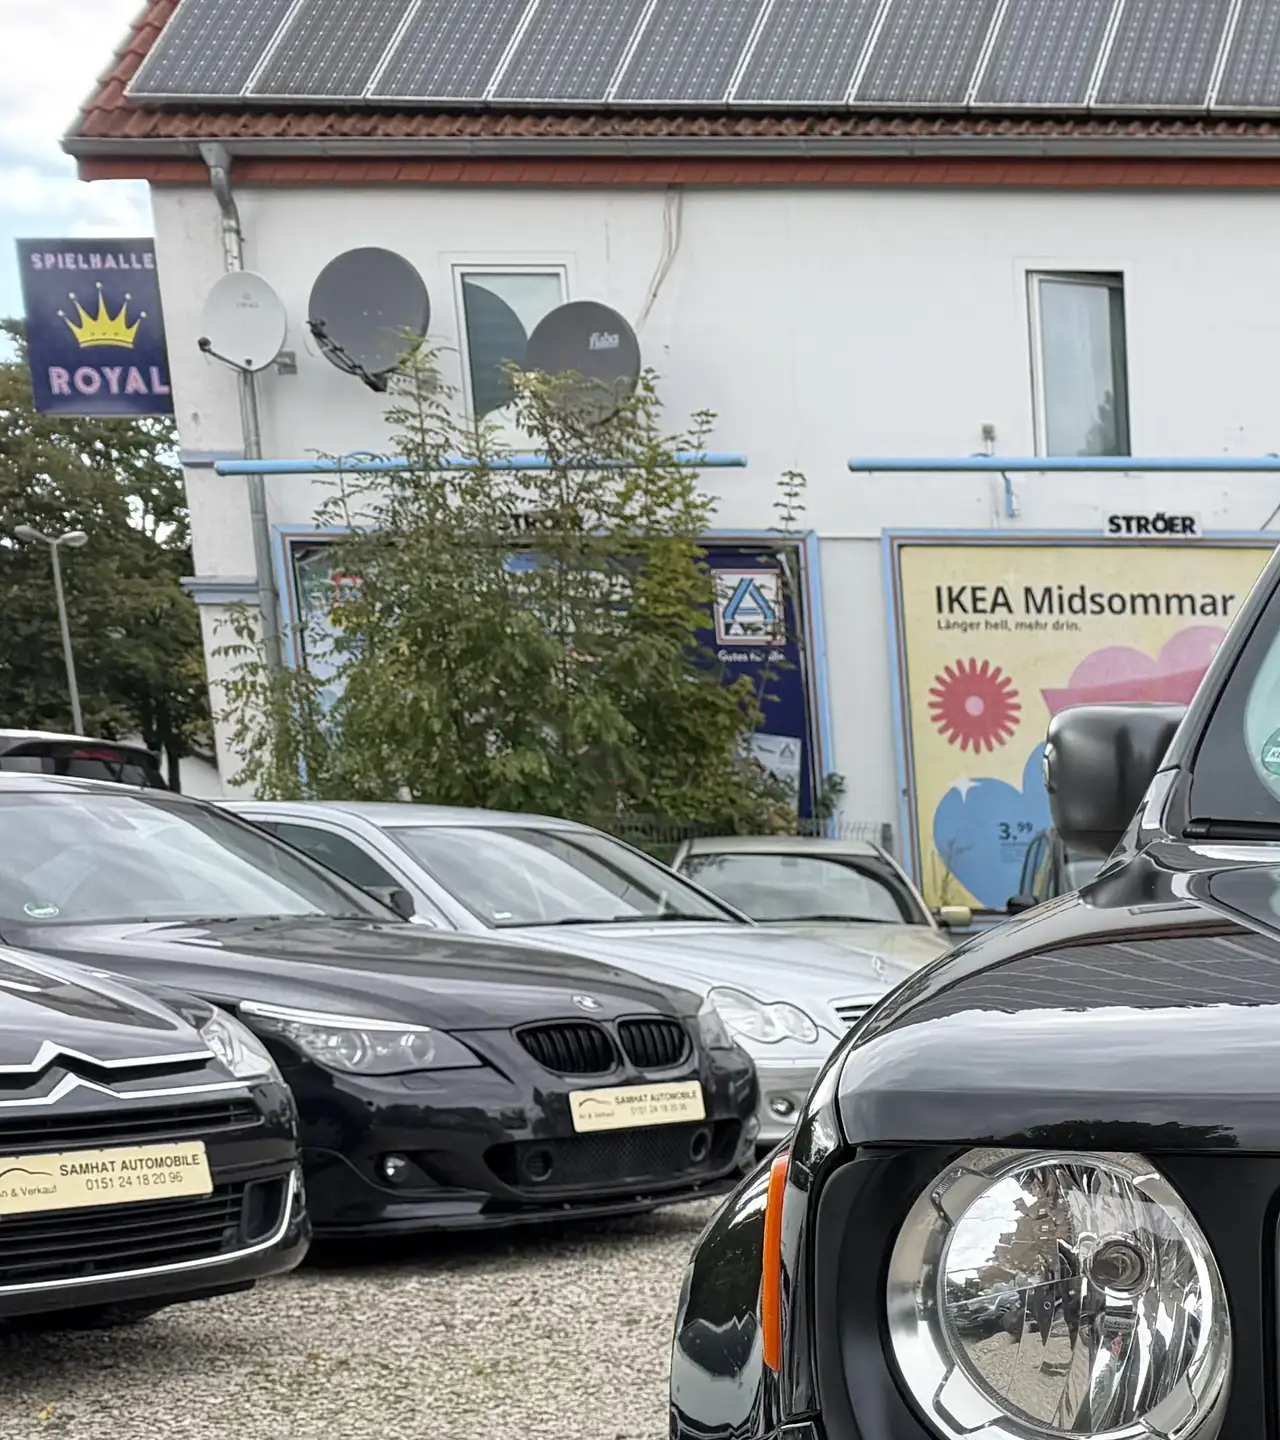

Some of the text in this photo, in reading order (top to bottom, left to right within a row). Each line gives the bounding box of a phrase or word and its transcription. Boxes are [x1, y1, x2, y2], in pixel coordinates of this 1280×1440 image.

[31, 252, 155, 269] SPIELHALLE
[48, 365, 170, 396] ROYAL
[1108, 512, 1197, 534] STRÖER
[935, 584, 1235, 616] IKEA Midsommar
[936, 619, 1081, 633] Länger hell, mehr drin.
[60, 1154, 200, 1176] SAMHAT AUTOMOBILE
[85, 1171, 183, 1191] 0151 24 18 20 96
